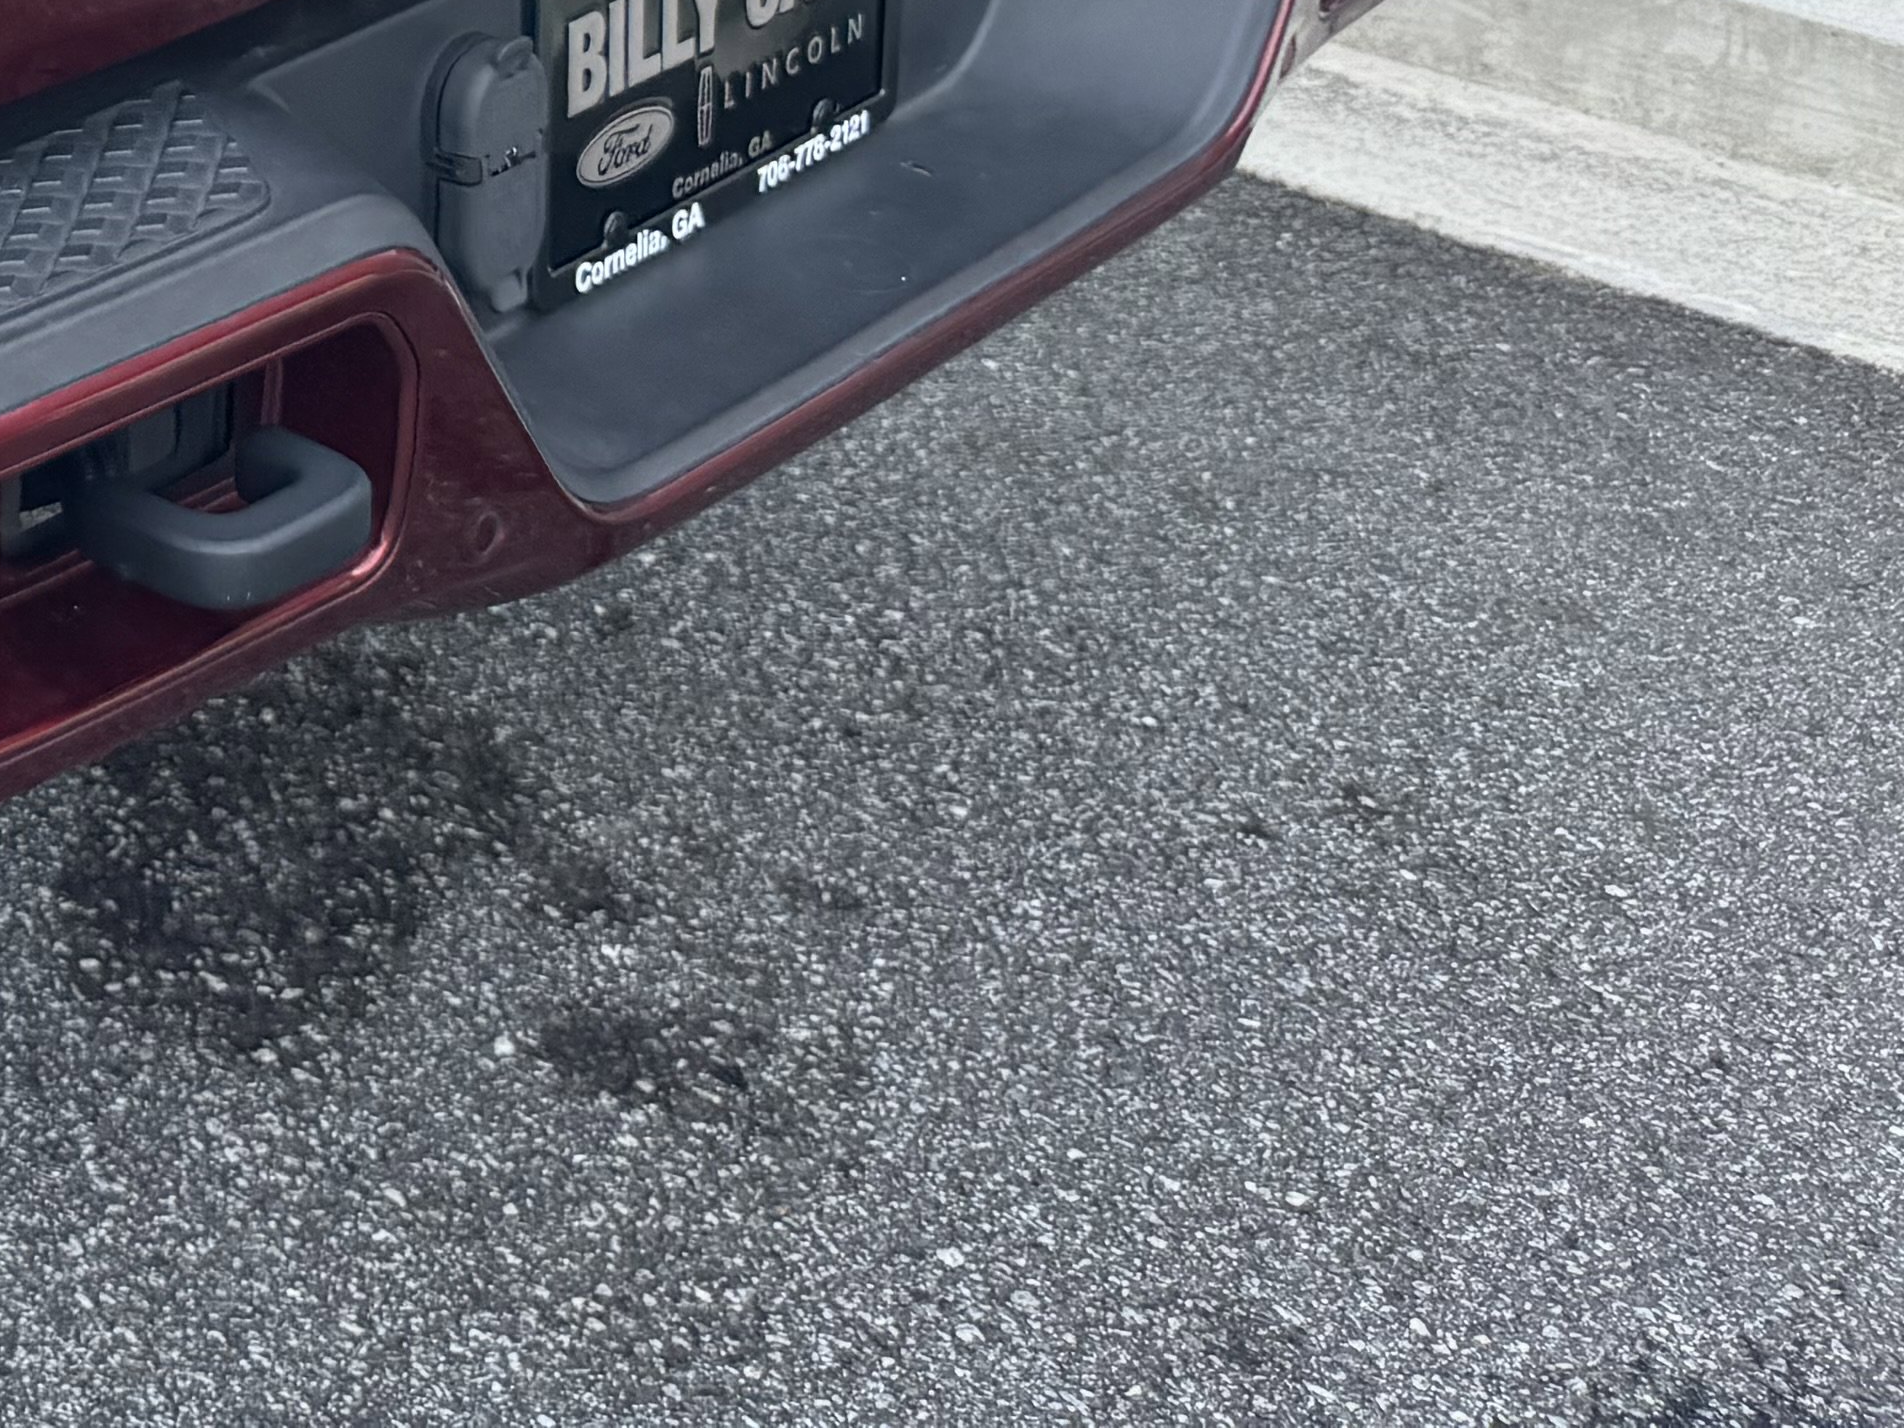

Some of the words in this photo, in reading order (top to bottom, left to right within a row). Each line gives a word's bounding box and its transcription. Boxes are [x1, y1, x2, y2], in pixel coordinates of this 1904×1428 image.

[724, 13, 864, 110] LINCOLN
[597, 122, 653, 176] Ford
[748, 129, 774, 159] GA
[671, 201, 707, 240] GA
